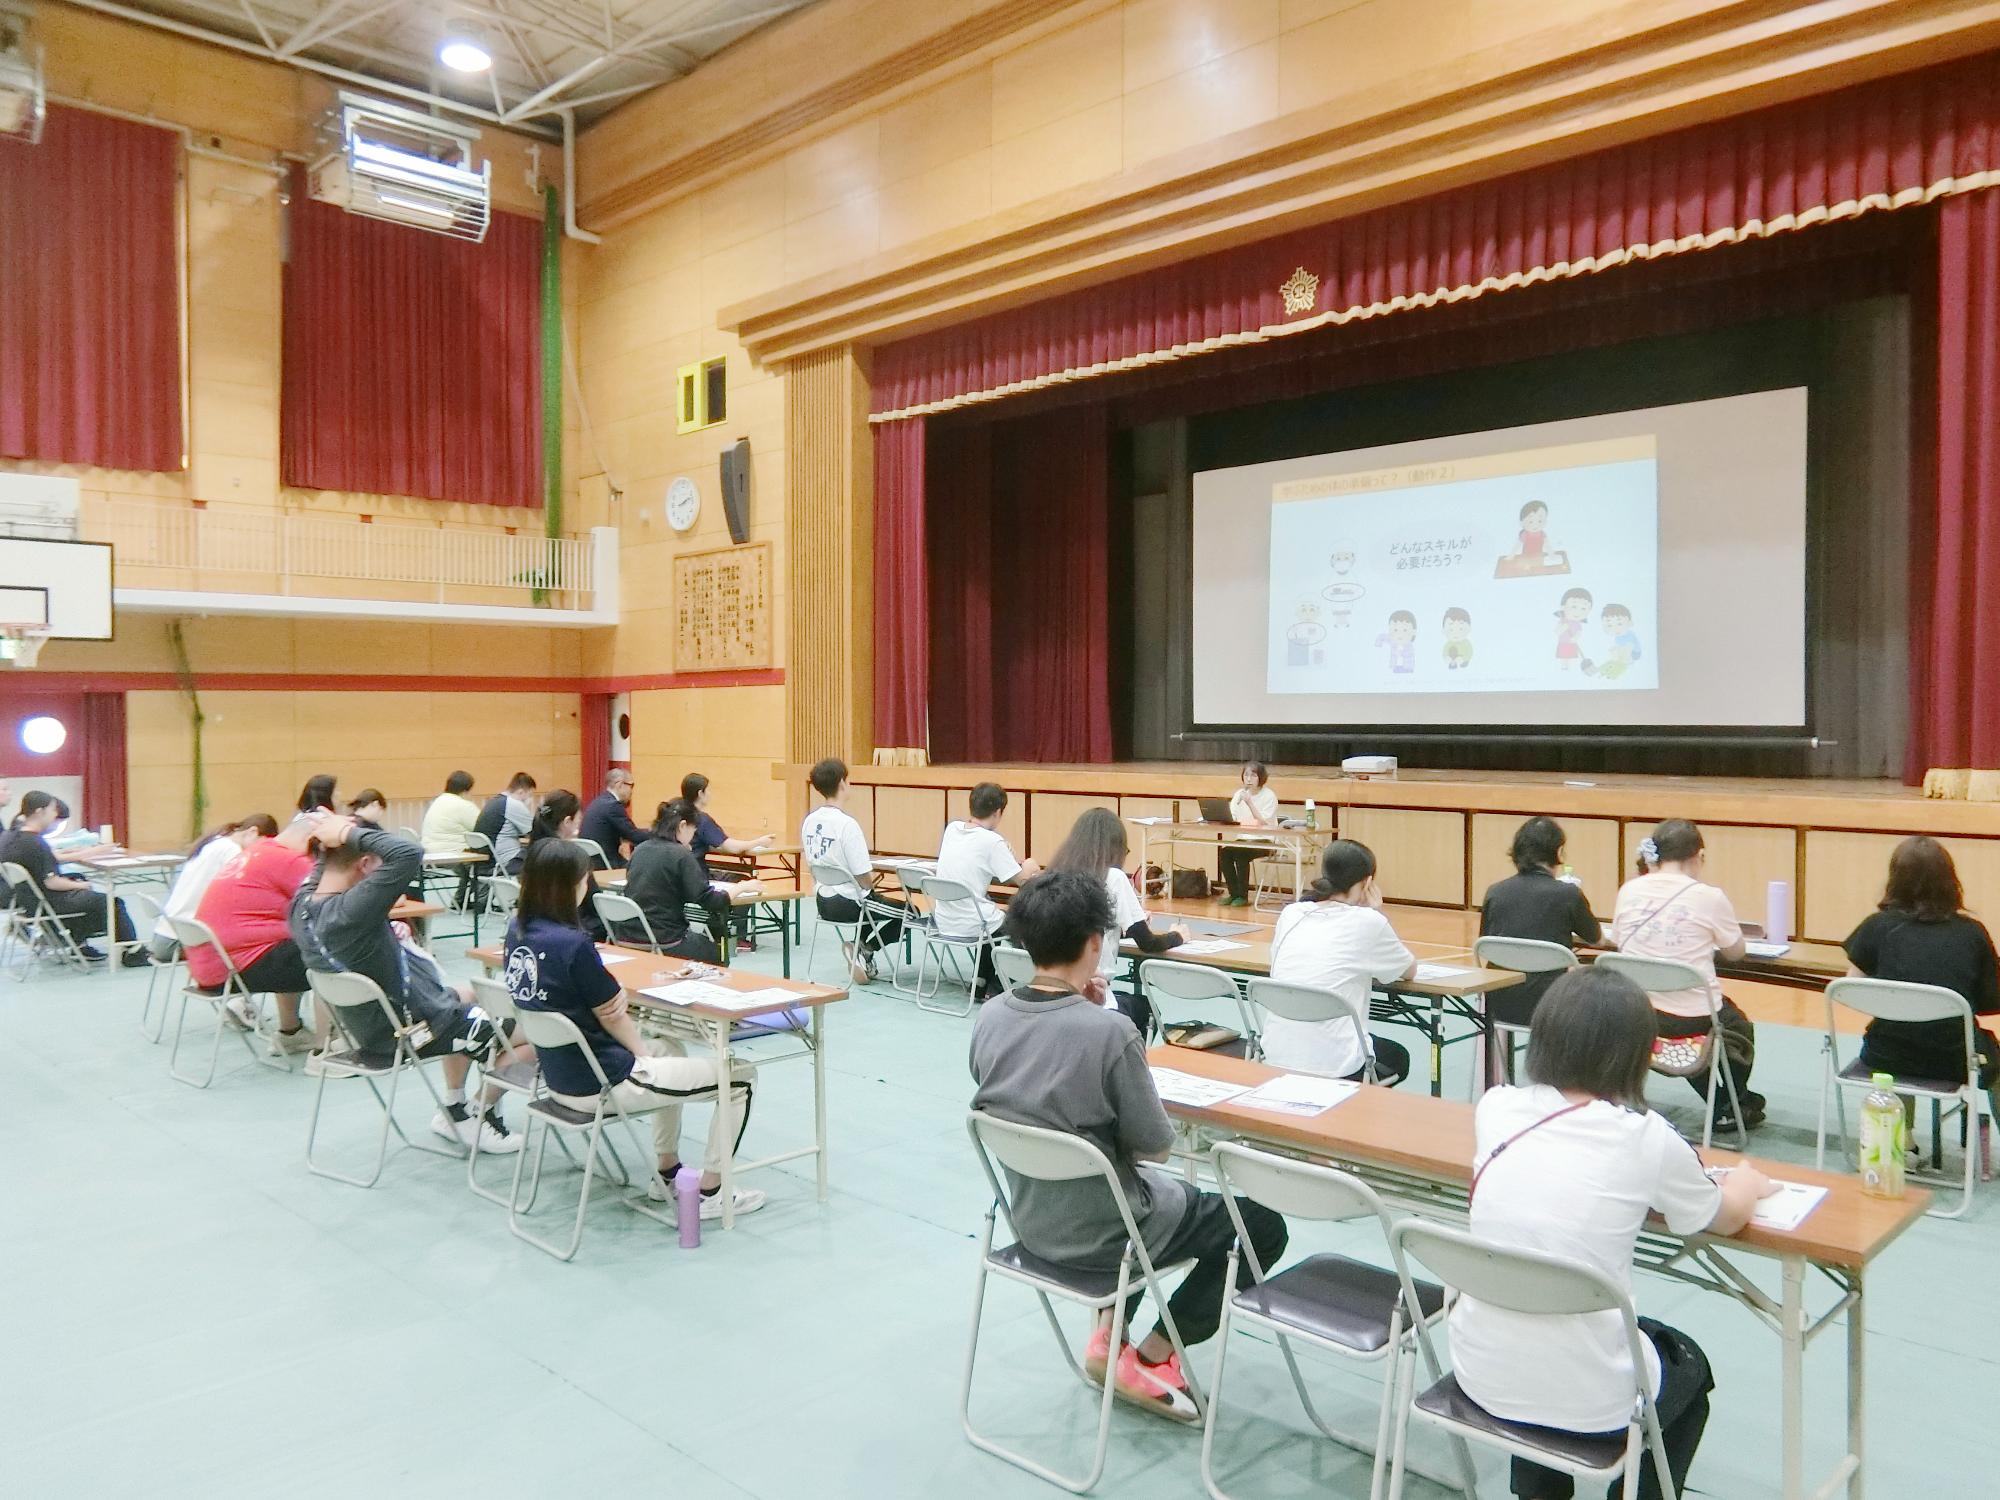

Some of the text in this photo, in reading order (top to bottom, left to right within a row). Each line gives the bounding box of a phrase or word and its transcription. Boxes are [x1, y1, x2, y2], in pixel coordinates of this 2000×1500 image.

[1390, 535, 1472, 555] どんなスキルが
[1396, 553, 1463, 570] 必要だろう？
